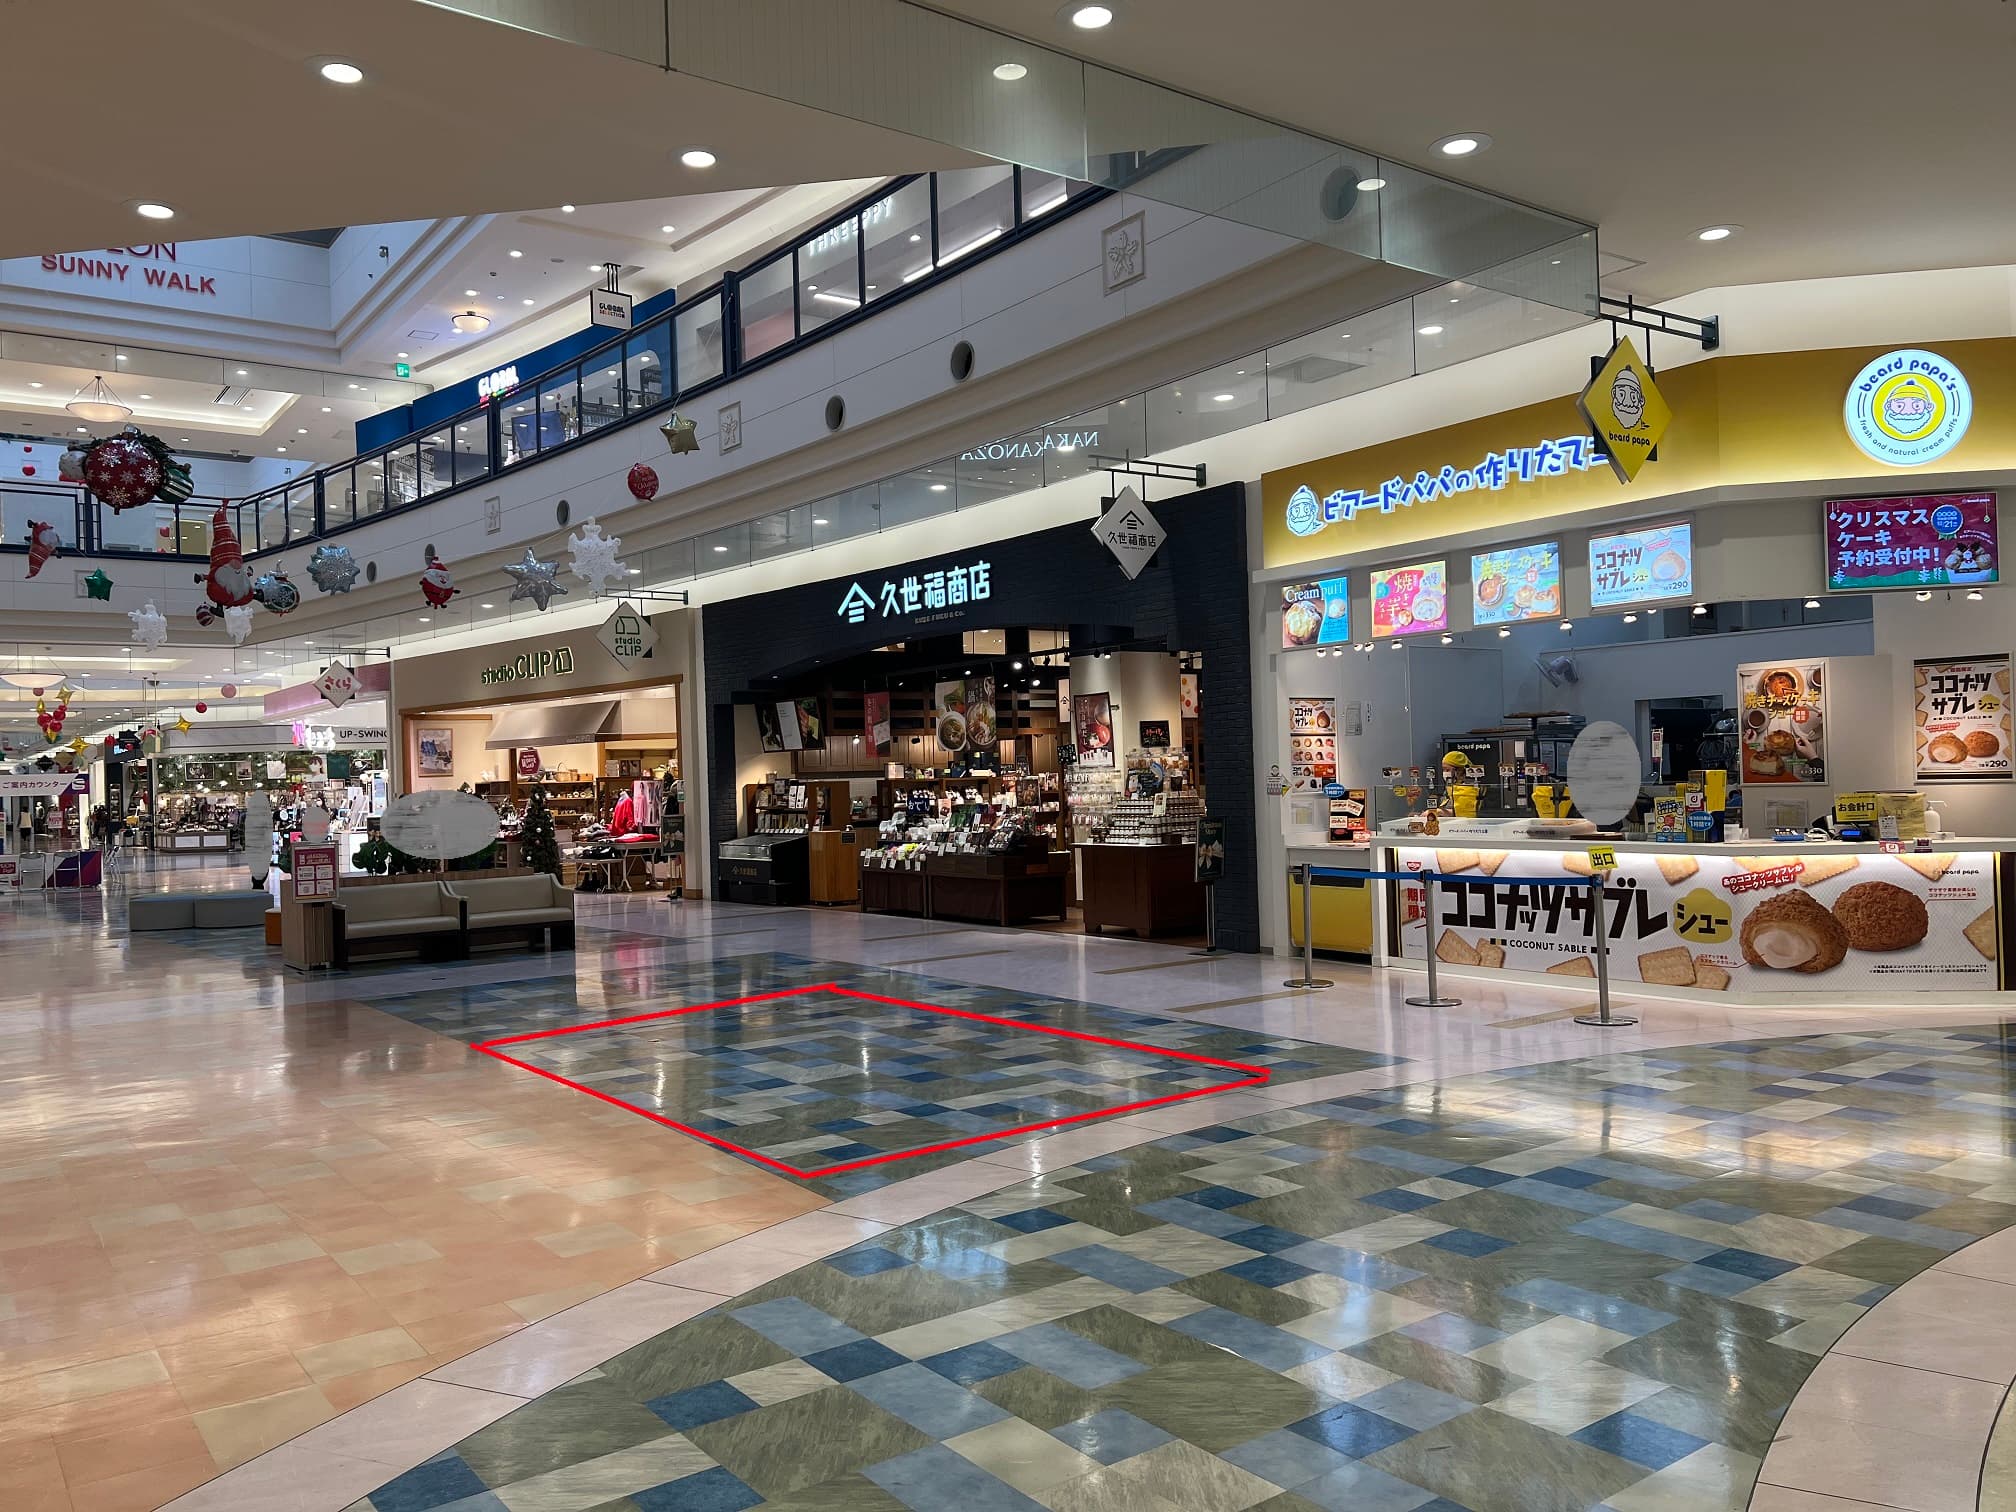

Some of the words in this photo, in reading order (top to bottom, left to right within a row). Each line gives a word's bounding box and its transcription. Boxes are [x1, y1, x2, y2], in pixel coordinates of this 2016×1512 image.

[41, 254, 129, 281] SUNNY
[143, 267, 216, 295] WALK
[1859, 357, 1903, 392] beard
[1909, 359, 1956, 391] papa's
[1609, 430, 1630, 443] beard
[1632, 437, 1650, 447] papa
[1872, 438, 1887, 450] and
[1888, 447, 1920, 456] natural
[1922, 437, 1945, 453] cream
[1944, 417, 1958, 438] puffs
[1836, 508, 1929, 529] クリスマス
[1108, 531, 1156, 547] 久世福商店
[1837, 529, 1892, 547] ケーキ
[1596, 547, 1642, 570] ココナッツ
[1837, 546, 1941, 568] 予約受付中!
[1597, 568, 1630, 590] サブレ
[880, 560, 991, 618] 久世福商店
[1285, 588, 1320, 603] Cream
[614, 636, 642, 645] studio
[615, 646, 642, 657] CLIP
[481, 663, 516, 685] studio
[515, 650, 552, 679] CLIP
[324, 676, 351, 690] さくら
[1931, 672, 1992, 693] ココナッツ
[1745, 688, 1820, 709] 焼きチーズケーキ
[1932, 693, 1975, 715] サブレ
[1978, 699, 1999, 710] シュー
[1768, 708, 1795, 719] シュー
[1475, 743, 1491, 751] papa
[1808, 767, 1822, 775] 330
[2, 780, 68, 789] ご案内カウンター
[1591, 852, 1615, 866] 出口
[1440, 876, 1669, 941] ココナッツサブレ
[1676, 902, 1729, 935] シュー
[1509, 938, 1555, 952] COCONUT
[1557, 941, 1588, 955] SABLE
